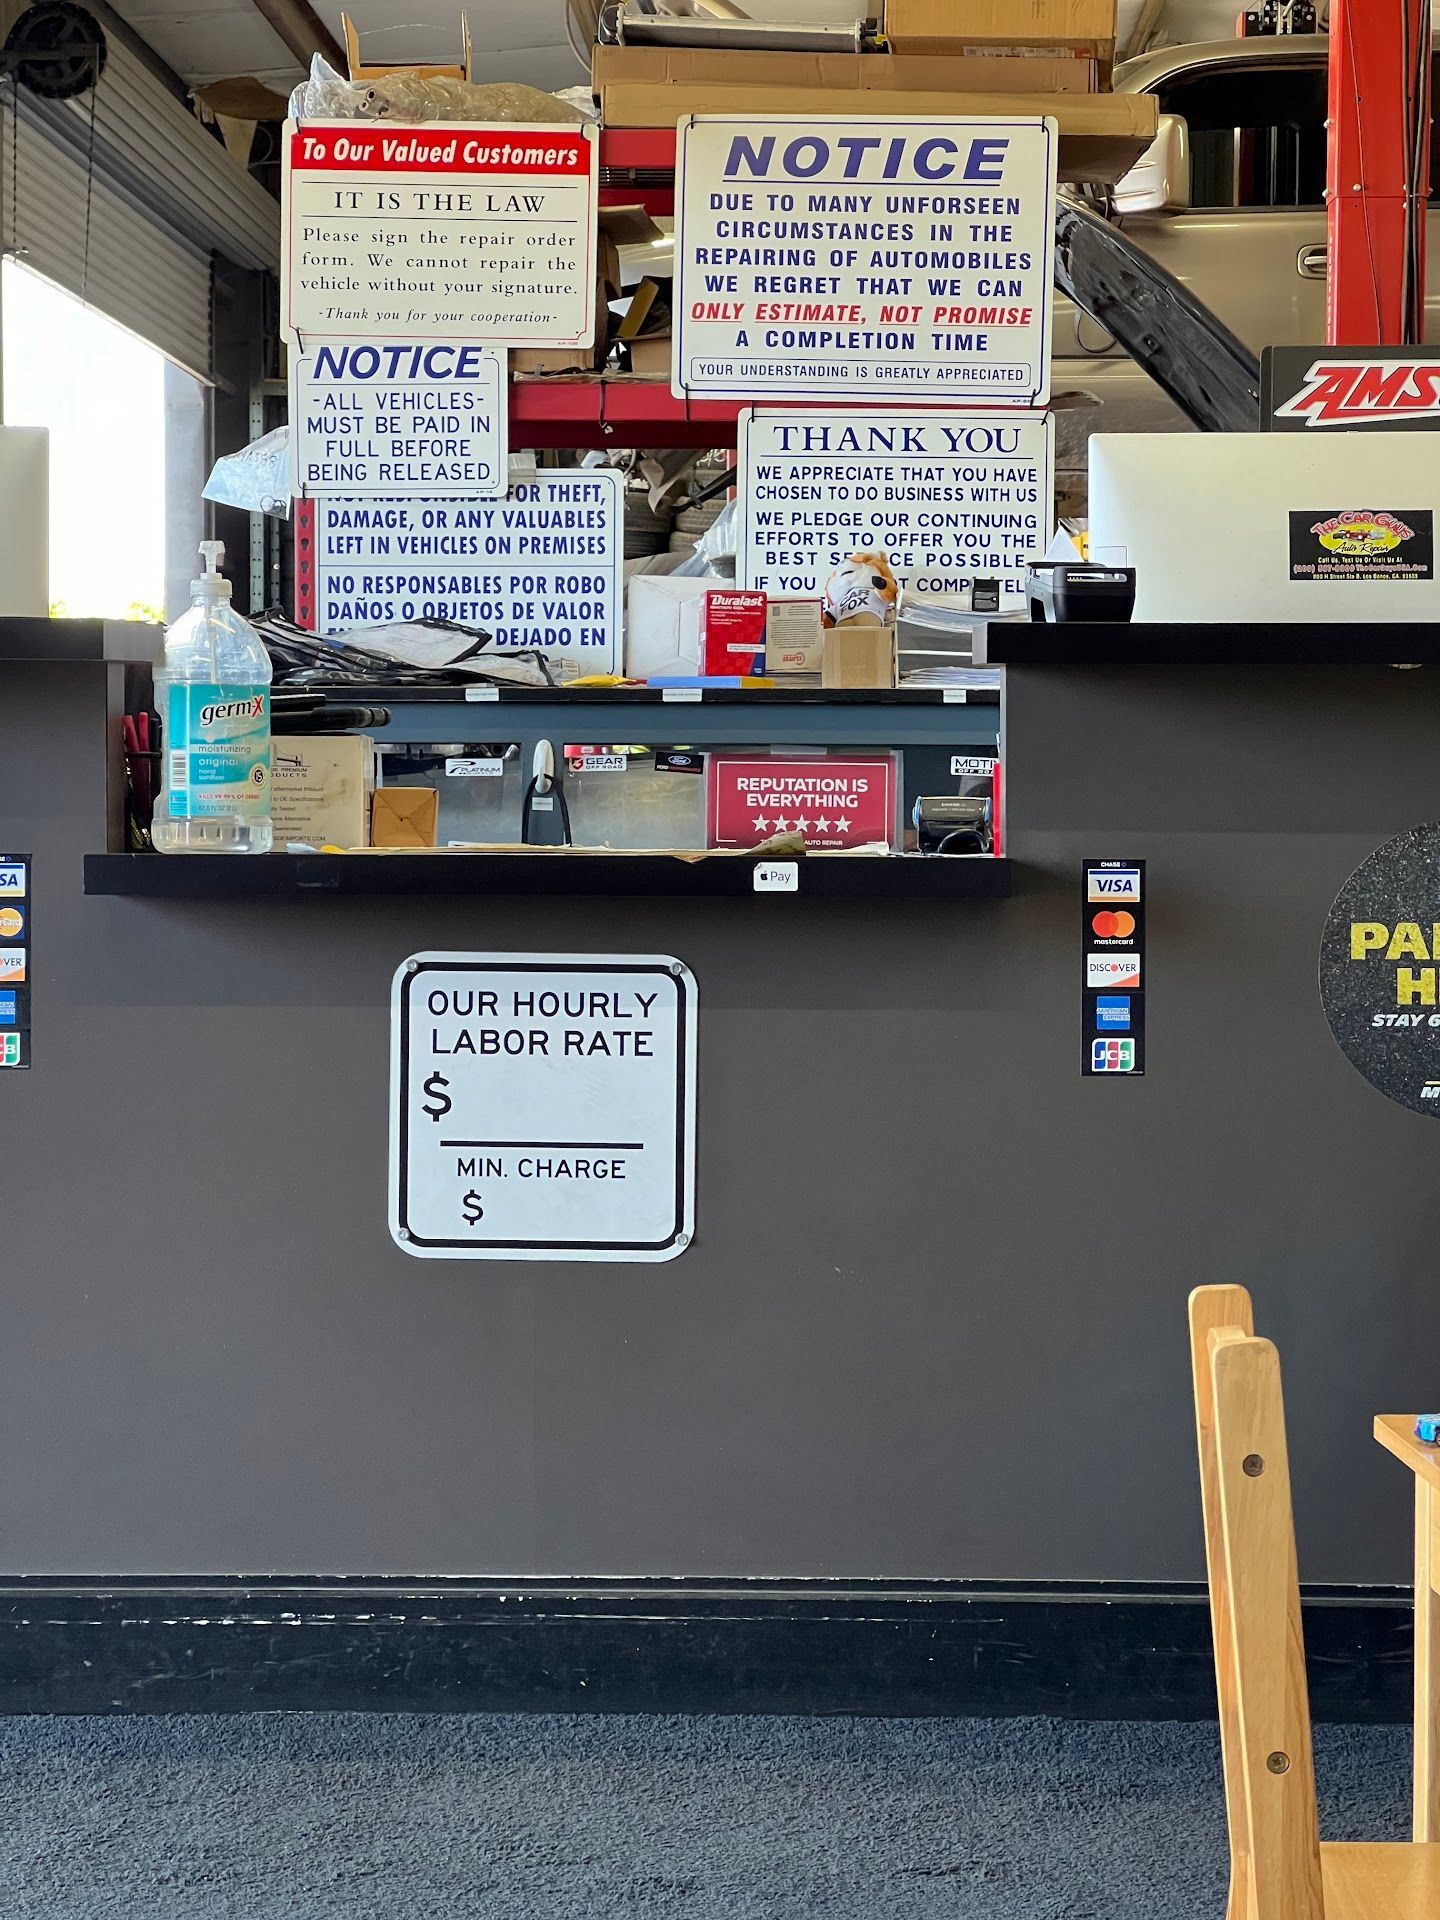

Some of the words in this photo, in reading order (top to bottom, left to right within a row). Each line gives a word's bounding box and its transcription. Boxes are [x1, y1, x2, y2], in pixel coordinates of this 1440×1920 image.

[303, 138, 326, 160] To
[334, 138, 374, 161] Our
[382, 139, 457, 163] Valued
[463, 141, 578, 165] Customers
[724, 136, 1010, 180] NOTICE
[335, 192, 363, 209] IT
[377, 193, 400, 210] IS
[413, 193, 472, 211] THE
[486, 195, 545, 212] LAW
[710, 193, 753, 211] DUE
[767, 194, 794, 212] TO
[808, 195, 872, 213] MANY
[886, 196, 1019, 215] UNFORSEEN
[303, 228, 359, 242] Please
[372, 229, 407, 247] sign
[420, 230, 448, 244] the
[460, 232, 514, 249] repair
[527, 233, 575, 246] order
[303, 251, 353, 266] form.
[367, 254, 393, 267] We
[406, 258, 467, 268] cannot
[480, 256, 535, 273] repair
[548, 257, 575, 270] the
[301, 276, 359, 290] vehicle
[368, 278, 435, 291] without
[444, 283, 483, 296] your
[492, 280, 577, 297] signature.
[705, 275, 737, 292] WE
[754, 276, 841, 294] REGRET
[856, 278, 912, 295] THAT
[928, 279, 961, 296] WE
[978, 279, 1022, 297] CAN
[319, 307, 368, 319] -Thank
[374, 312, 399, 322] you
[405, 309, 427, 323] for
[432, 313, 464, 323] your
[471, 311, 557, 324] cooperation-
[691, 302, 745, 321] ONLY
[755, 303, 867, 325] ESTIMATE,
[879, 305, 923, 323] NOT
[932, 306, 1033, 325] PROMISE
[736, 330, 749, 347] A
[766, 330, 914, 350] COMPLETION
[931, 333, 987, 351] TIME
[313, 346, 483, 379] NOTICE
[699, 364, 733, 375] YOUR
[741, 365, 848, 377] UNDERSTANDING
[856, 366, 867, 378] IS
[875, 367, 930, 379] GREATLY
[936, 368, 1023, 381] APPRECIATED
[313, 393, 363, 410] -ALL
[375, 392, 484, 410] VEHICLES-
[308, 416, 364, 434] MUST
[376, 416, 401, 433] BE
[413, 416, 460, 433] PAID
[471, 416, 490, 433] IN
[326, 440, 379, 457] FULL
[392, 439, 471, 457] BEFORE
[773, 426, 928, 452] THANK
[940, 427, 1021, 453] YOU
[308, 463, 367, 481] BEING
[379, 463, 490, 481] RELEASED
[757, 466, 782, 480] WE
[789, 466, 894, 481] APPRECIATE
[900, 467, 945, 481] THAT
[952, 468, 986, 482] YOU
[994, 468, 1037, 482] HAVE
[506, 484, 541, 503] FOR
[547, 484, 605, 506] THEFT,
[756, 486, 821, 500] CHOSEN
[828, 486, 849, 500] TO
[856, 487, 878, 500] DO
[885, 487, 964, 501] BUSINESS
[971, 488, 1010, 502] WITH
[1016, 488, 1037, 502] US
[328, 510, 414, 532] DAMAGE,
[422, 510, 447, 528] OR
[454, 510, 495, 528] ANY
[502, 510, 606, 529] VALUABLES
[756, 512, 784, 526] WE
[792, 512, 863, 526] PLEDGE
[871, 513, 909, 527] OUR
[918, 513, 1037, 528] CONTINUING
[1310, 517, 1339, 537] THE
[1338, 511, 1373, 526] CAR
[1374, 512, 1416, 541] GUYS
[755, 531, 838, 546] EFFORTS
[849, 532, 874, 546] TO
[884, 533, 943, 547] OFFER
[953, 534, 991, 548] YOU
[1001, 534, 1036, 548] THE
[1333, 541, 1358, 553] Auto
[1359, 542, 1389, 555] Repair
[766, 551, 818, 565] BEST
[926, 553, 1025, 568] POSSIBLE
[328, 576, 354, 594] NO
[363, 576, 502, 594] RESPONSABLES
[510, 576, 547, 594] POR
[555, 576, 605, 594] ROBO
[755, 576, 769, 590] IF
[778, 576, 816, 590] YOU
[328, 597, 394, 620] DAÑOS
[402, 601, 414, 620] O
[422, 600, 503, 621] OBJETOS
[512, 602, 534, 620] DE
[542, 602, 605, 620] VALOR
[710, 594, 763, 606] Duralast
[496, 628, 571, 646] DEJADO
[580, 628, 605, 646] EN
[198, 745, 252, 754] moisturizing
[198, 756, 238, 767] original
[586, 757, 623, 765] GEAR
[737, 778, 847, 792] REPUTATION
[852, 779, 868, 792] IS
[747, 793, 858, 808] EVERYTHING
[770, 871, 792, 883] Pay
[1095, 879, 1133, 893] VISA
[1089, 963, 1137, 973] DISCOVER
[428, 990, 498, 1016] OUR
[514, 991, 658, 1018] HOURLY
[1372, 1014, 1425, 1027] STAY
[433, 1029, 549, 1055] LABOR
[564, 1030, 653, 1056] RATE
[1094, 1049, 1131, 1061] JCB
[422, 1071, 452, 1122] $
[458, 1158, 508, 1178] MIN.
[518, 1158, 626, 1179] CHARGE
[462, 1189, 483, 1226] $
